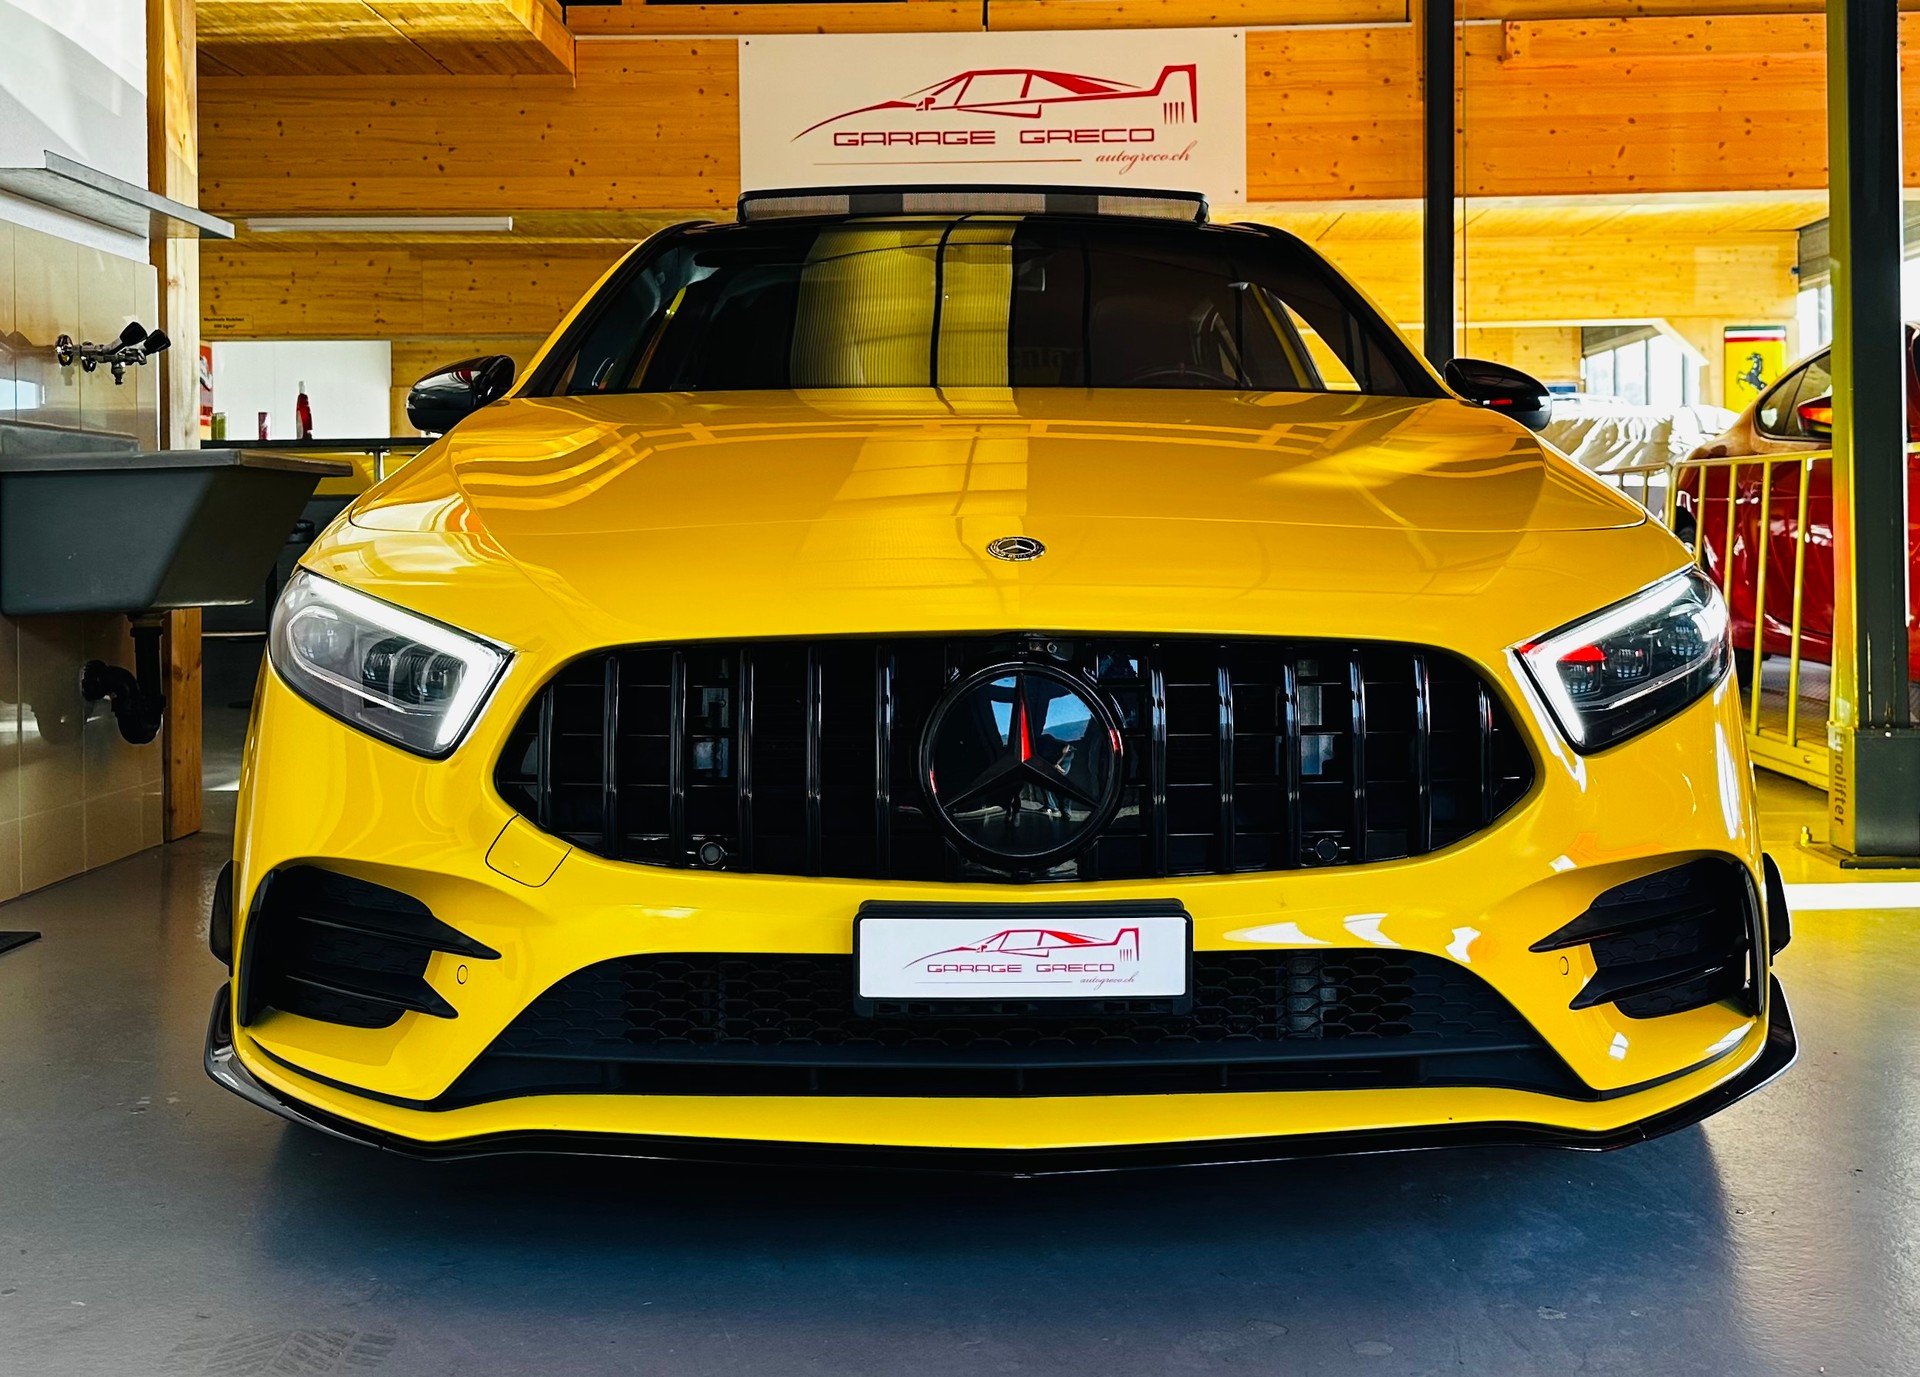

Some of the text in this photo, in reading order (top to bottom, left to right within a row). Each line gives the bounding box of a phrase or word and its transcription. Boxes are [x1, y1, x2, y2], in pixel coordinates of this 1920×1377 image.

[833, 128, 1156, 147] GARAGE GRECO
[1095, 141, 1198, 174] autogreco.ch
[927, 963, 1115, 973] GARAGE GRECO
